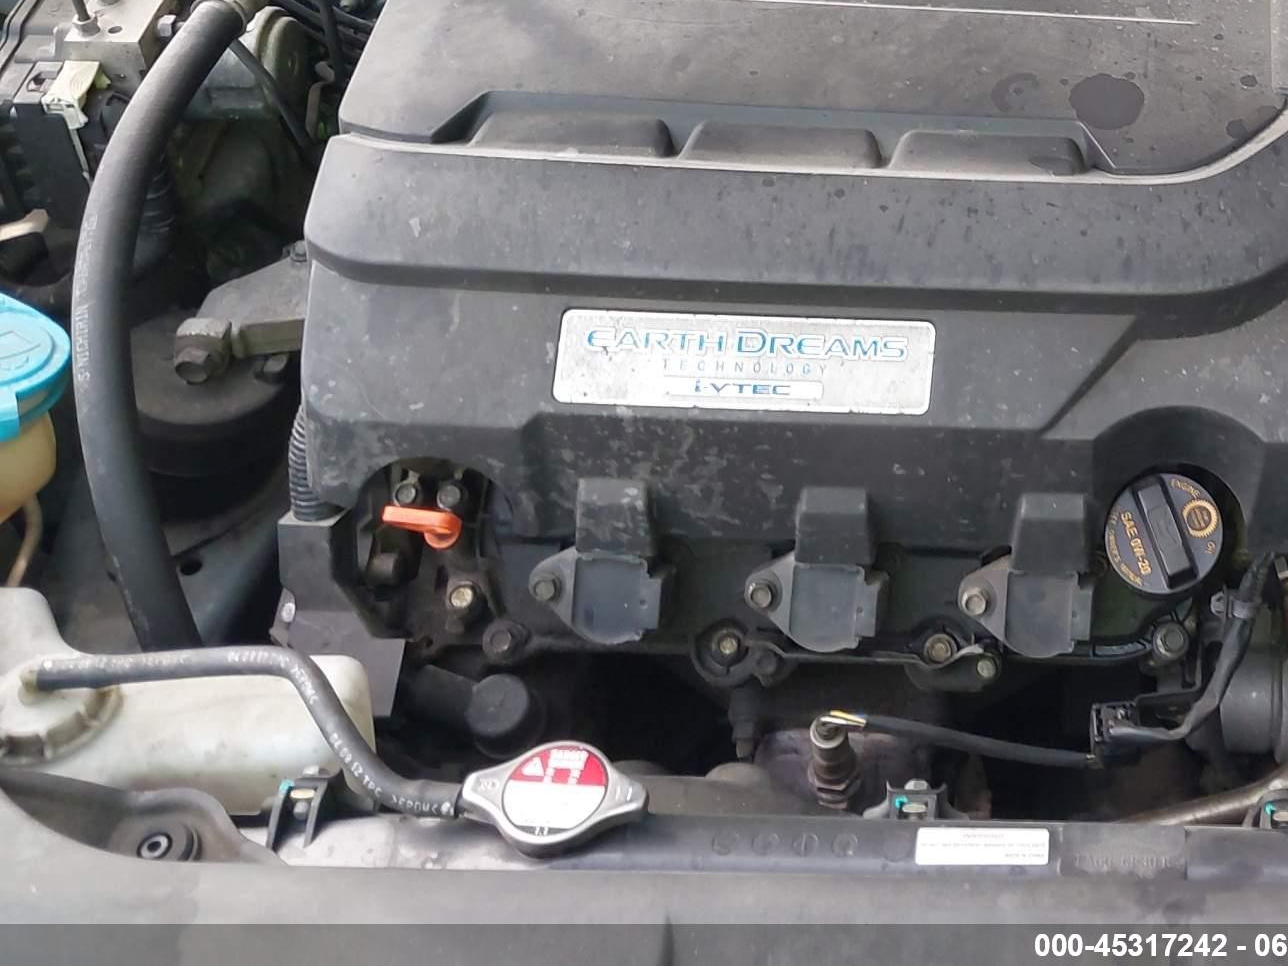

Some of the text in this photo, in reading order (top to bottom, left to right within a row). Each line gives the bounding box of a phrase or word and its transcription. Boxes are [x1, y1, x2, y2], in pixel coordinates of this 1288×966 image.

[586, 328, 908, 360] EARTH DREAMS
[662, 359, 828, 377] TECHNOLOGY
[1170, 478, 1201, 499] ENGINE
[1121, 511, 1153, 576] SAE 0W-20
